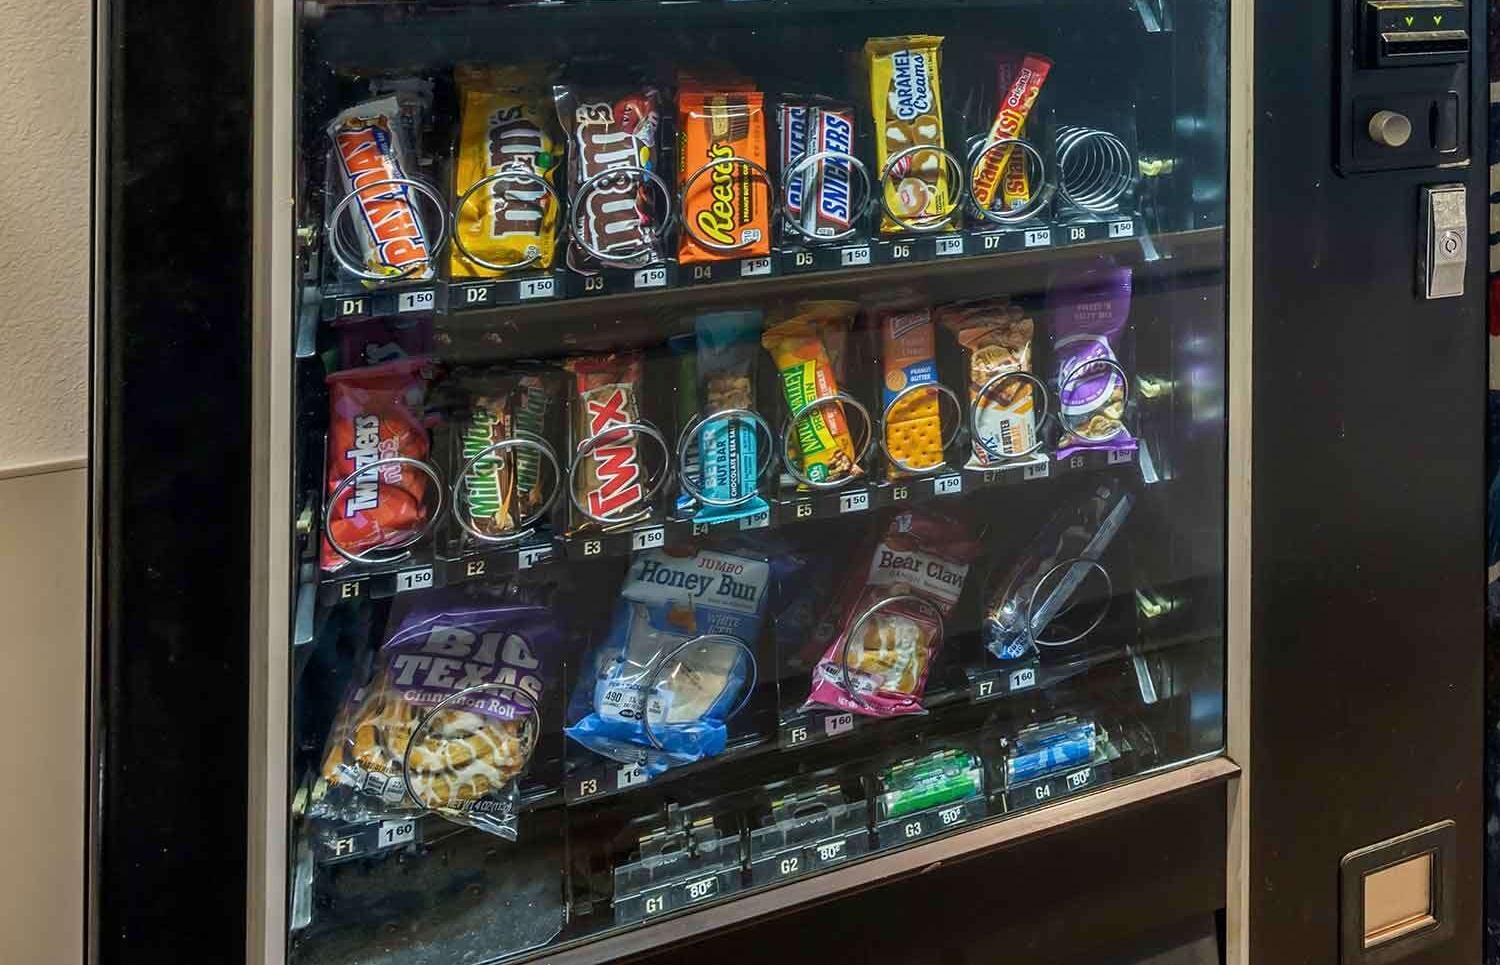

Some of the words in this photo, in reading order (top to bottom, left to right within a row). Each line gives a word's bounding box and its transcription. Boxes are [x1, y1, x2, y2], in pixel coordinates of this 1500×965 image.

[896, 50, 913, 117] CARAMEL
[912, 54, 927, 112] Creams
[1008, 69, 1031, 107] Original
[821, 114, 852, 219] SNICKERS
[338, 129, 429, 266] PAYDAY
[698, 143, 735, 246] Reese's
[985, 237, 1000, 249] D7
[1071, 228, 1086, 240] D8
[796, 253, 813, 265] D5
[894, 246, 909, 258] D6
[695, 266, 712, 279] D4
[585, 278, 604, 291] D3
[467, 289, 487, 302] D2
[343, 301, 364, 315] D1
[783, 369, 803, 413] VALLEY
[578, 389, 641, 517] TWIX
[716, 440, 727, 462] BAR
[729, 439, 737, 452] SEA
[346, 415, 380, 518] Twizzlers
[704, 429, 717, 489] BETTER
[717, 464, 728, 486] NUT
[730, 458, 738, 497] CHOCOLATE
[464, 456, 505, 518] Milky
[893, 488, 908, 501] E6
[797, 505, 812, 517] E5
[584, 542, 601, 555] E3
[467, 561, 485, 576] E2
[698, 557, 744, 576] JUMBO
[879, 549, 924, 574] Bear
[638, 559, 715, 597] Honey
[716, 574, 758, 602] Bun
[342, 583, 360, 598] E1
[421, 626, 540, 670] BIG
[394, 653, 543, 707] TEXAS
[979, 682, 994, 696] F7
[403, 689, 487, 710] Cinnamon
[487, 697, 516, 718] Roll
[604, 691, 622, 704] 490
[791, 728, 808, 744] F5
[580, 779, 598, 796] F3
[1035, 784, 1051, 800] G4
[905, 822, 922, 837] G3
[336, 839, 355, 855] F1
[780, 857, 799, 875] G2
[645, 895, 665, 914] G1
